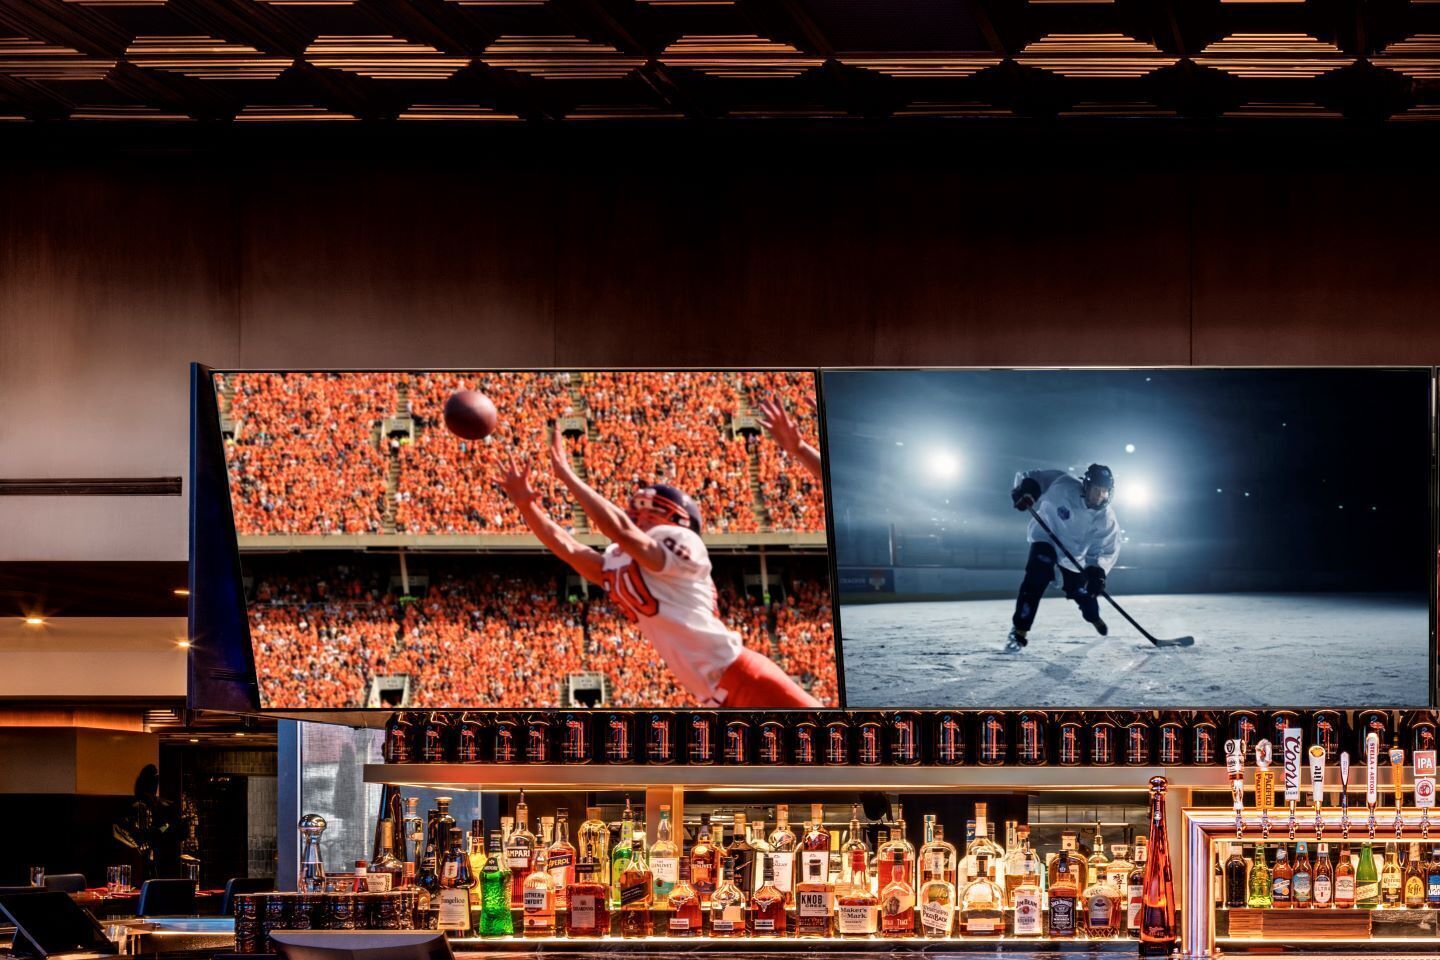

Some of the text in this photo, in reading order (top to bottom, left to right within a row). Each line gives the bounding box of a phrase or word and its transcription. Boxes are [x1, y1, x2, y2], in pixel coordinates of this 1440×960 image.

[1285, 736, 1301, 790] Coors
[1417, 757, 1433, 769] IPA
[1313, 765, 1323, 783] Lite
[507, 849, 531, 858] AMPARI
[801, 894, 823, 904] KNOB
